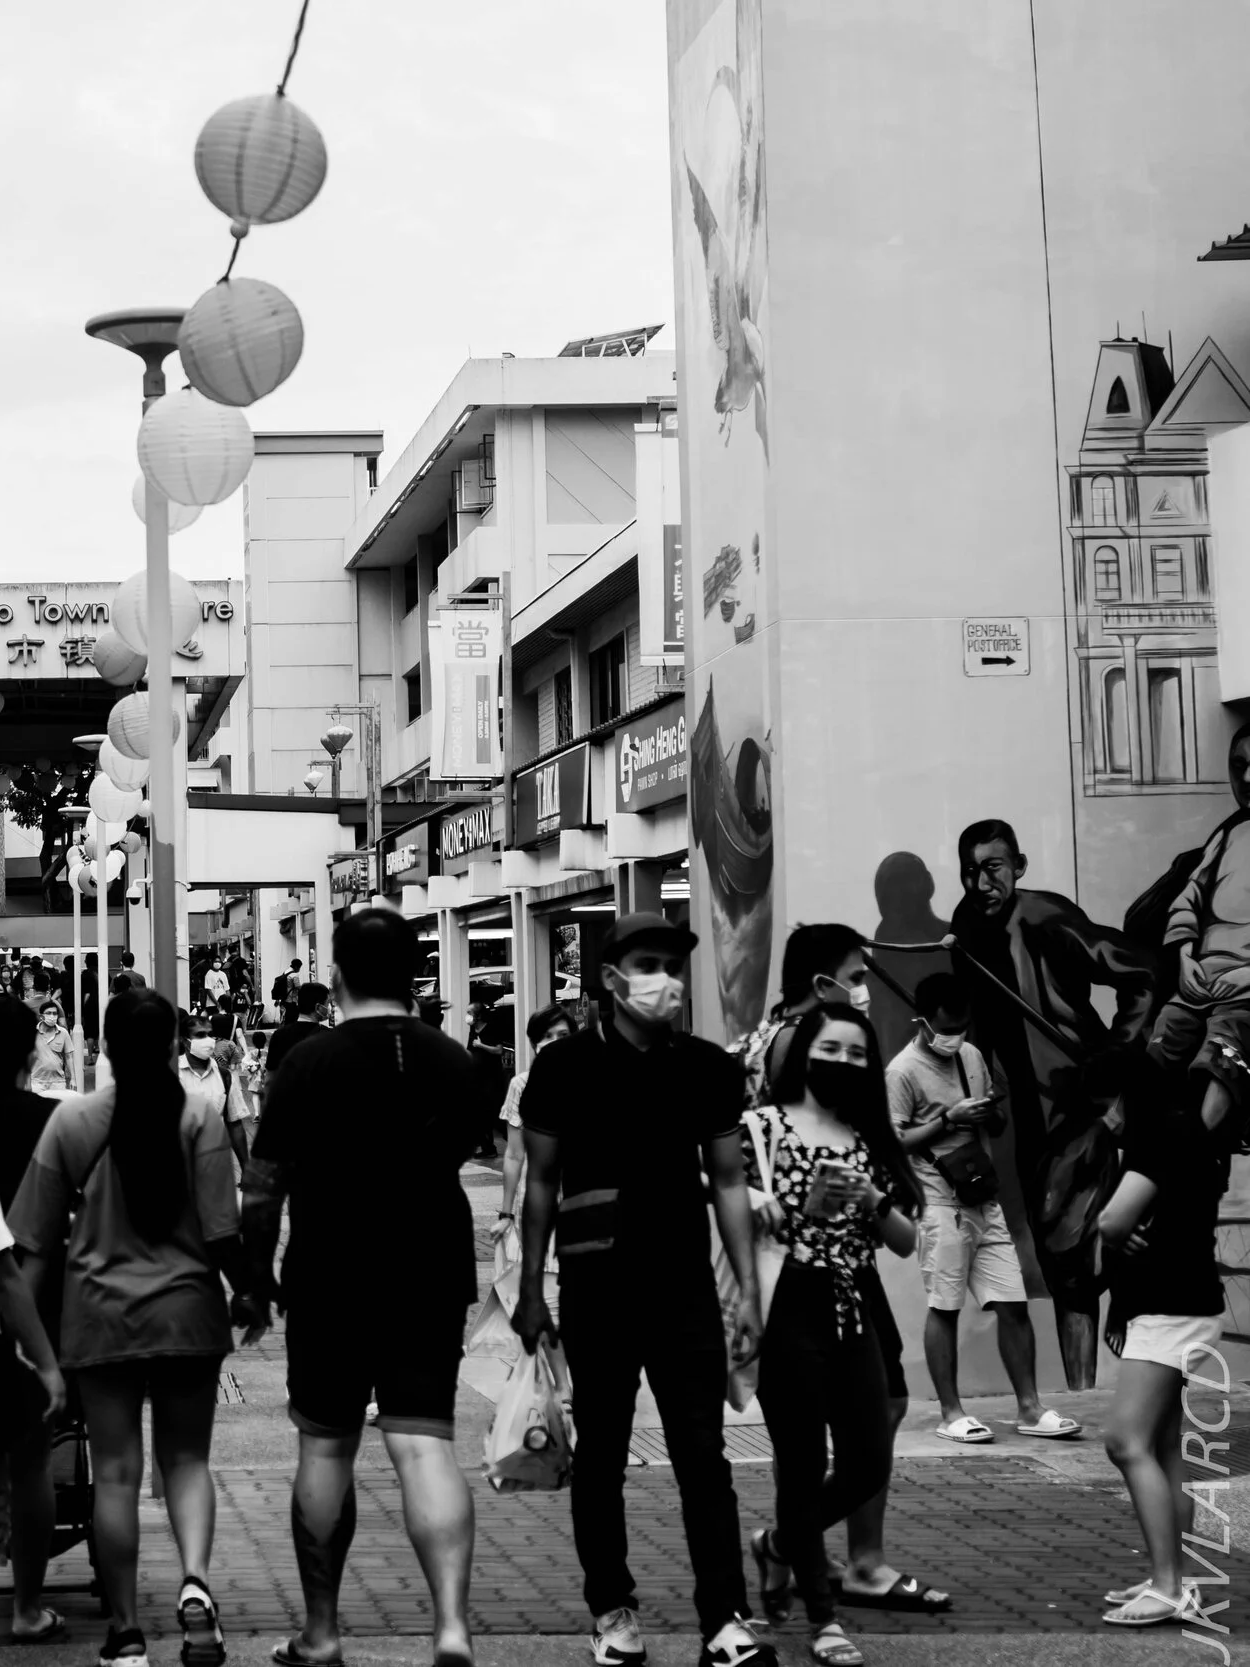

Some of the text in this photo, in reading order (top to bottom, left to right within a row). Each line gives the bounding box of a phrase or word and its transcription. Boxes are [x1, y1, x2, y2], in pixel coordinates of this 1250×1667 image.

[27, 595, 110, 624] Town
[967, 624, 1017, 637] GENERAL
[967, 639, 1022, 652] POST OFFICE
[656, 725, 677, 762] HENG
